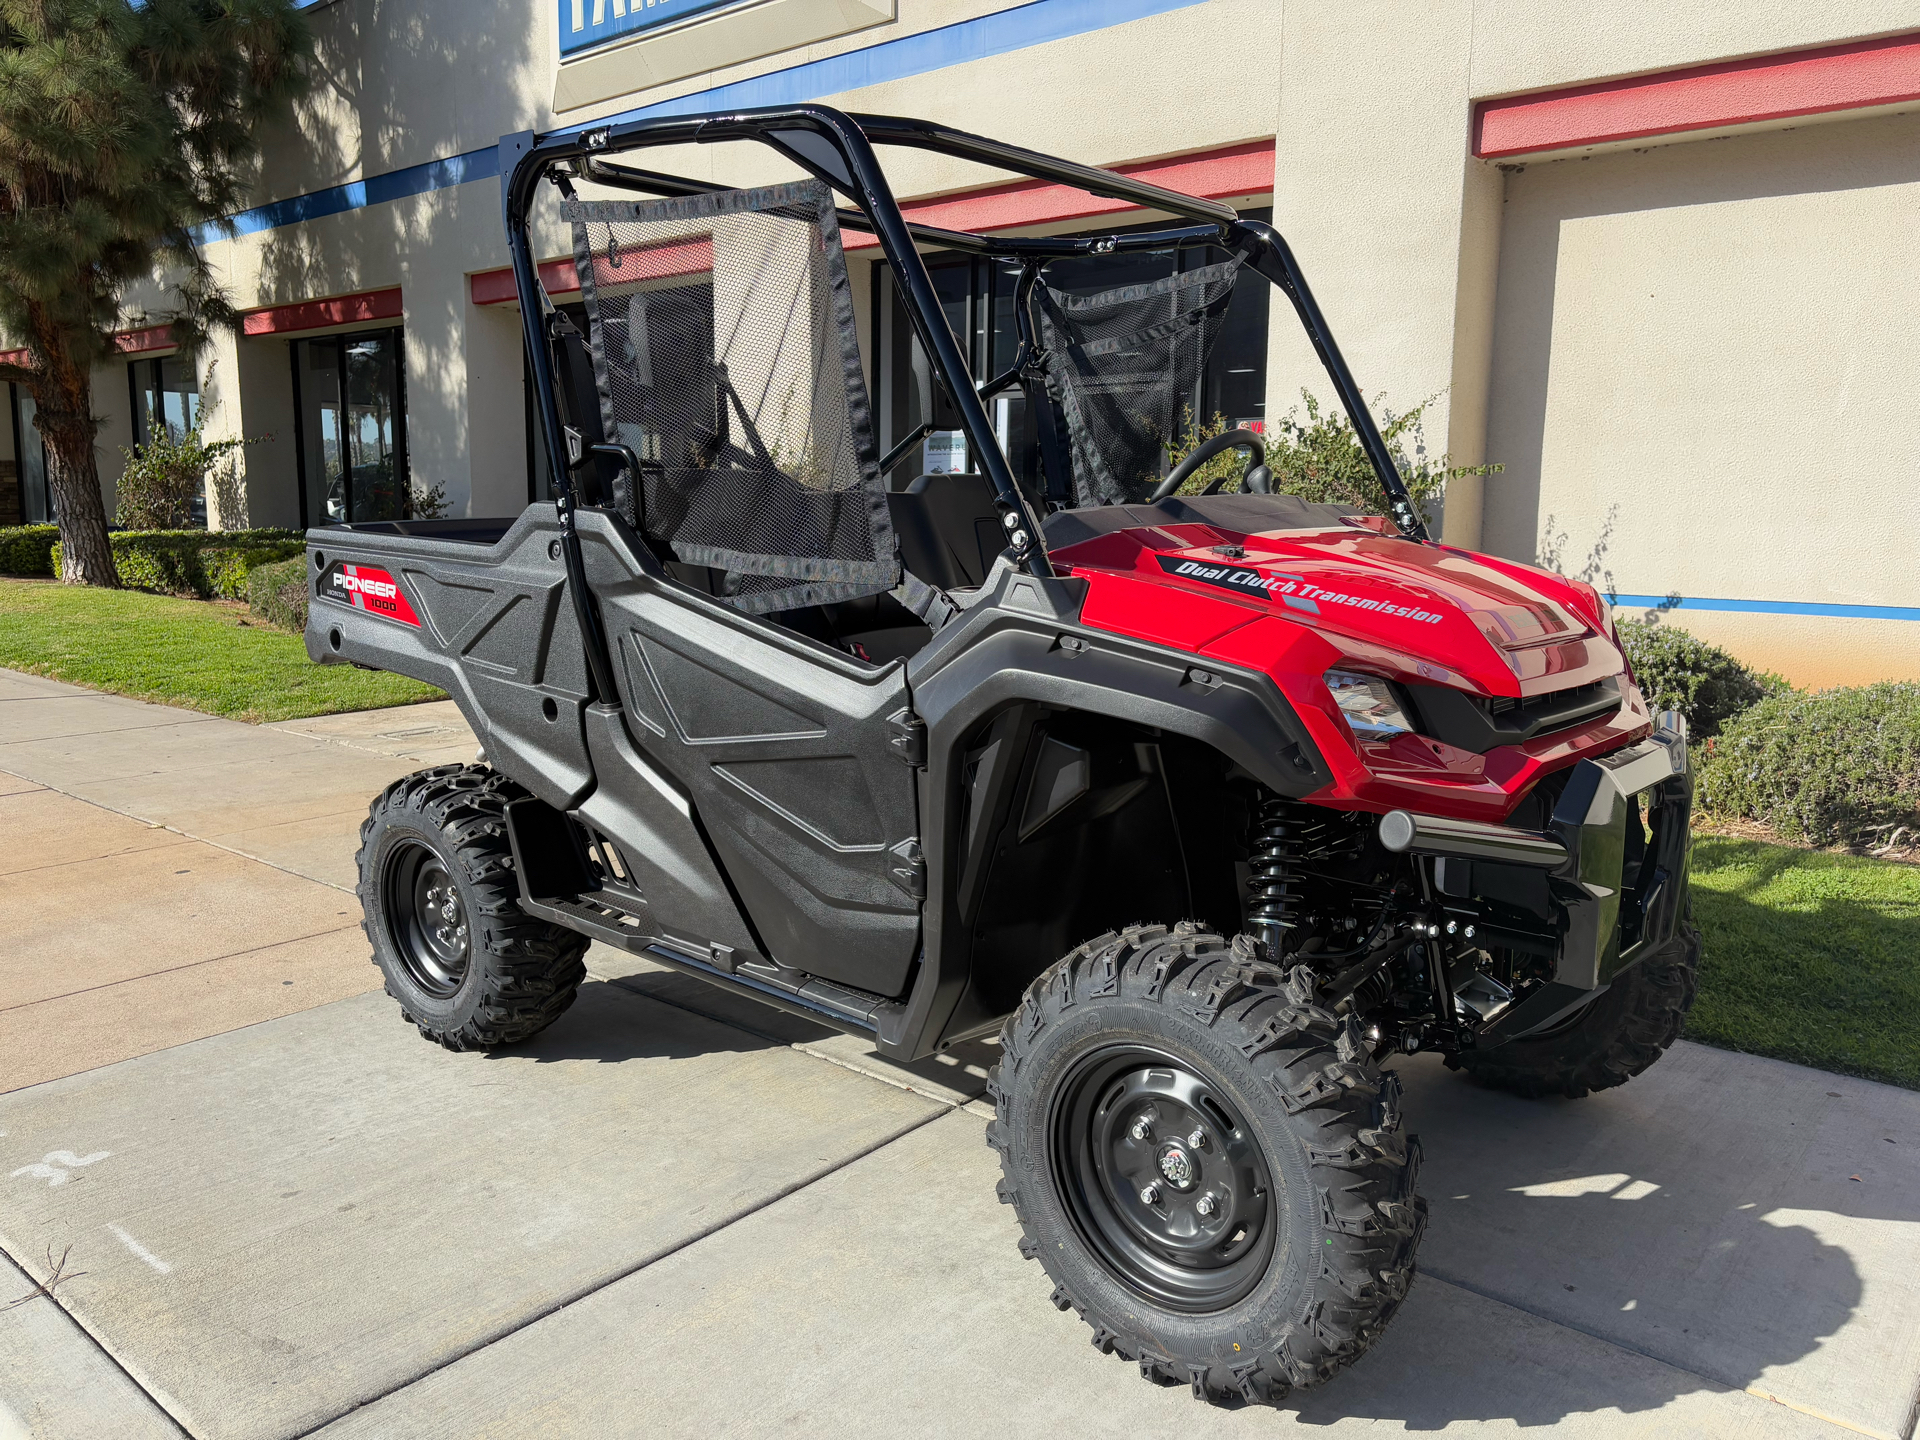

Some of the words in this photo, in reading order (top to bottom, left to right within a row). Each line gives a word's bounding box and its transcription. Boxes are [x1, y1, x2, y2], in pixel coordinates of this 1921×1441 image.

[1250, 421, 1266, 434] YA
[333, 572, 396, 599] PIONEER
[326, 588, 346, 599] HONDA
[1174, 561, 1223, 580] Dual
[1227, 571, 1297, 595] Clutch
[1297, 584, 1443, 624] Transmission
[370, 598, 397, 611] 1000
